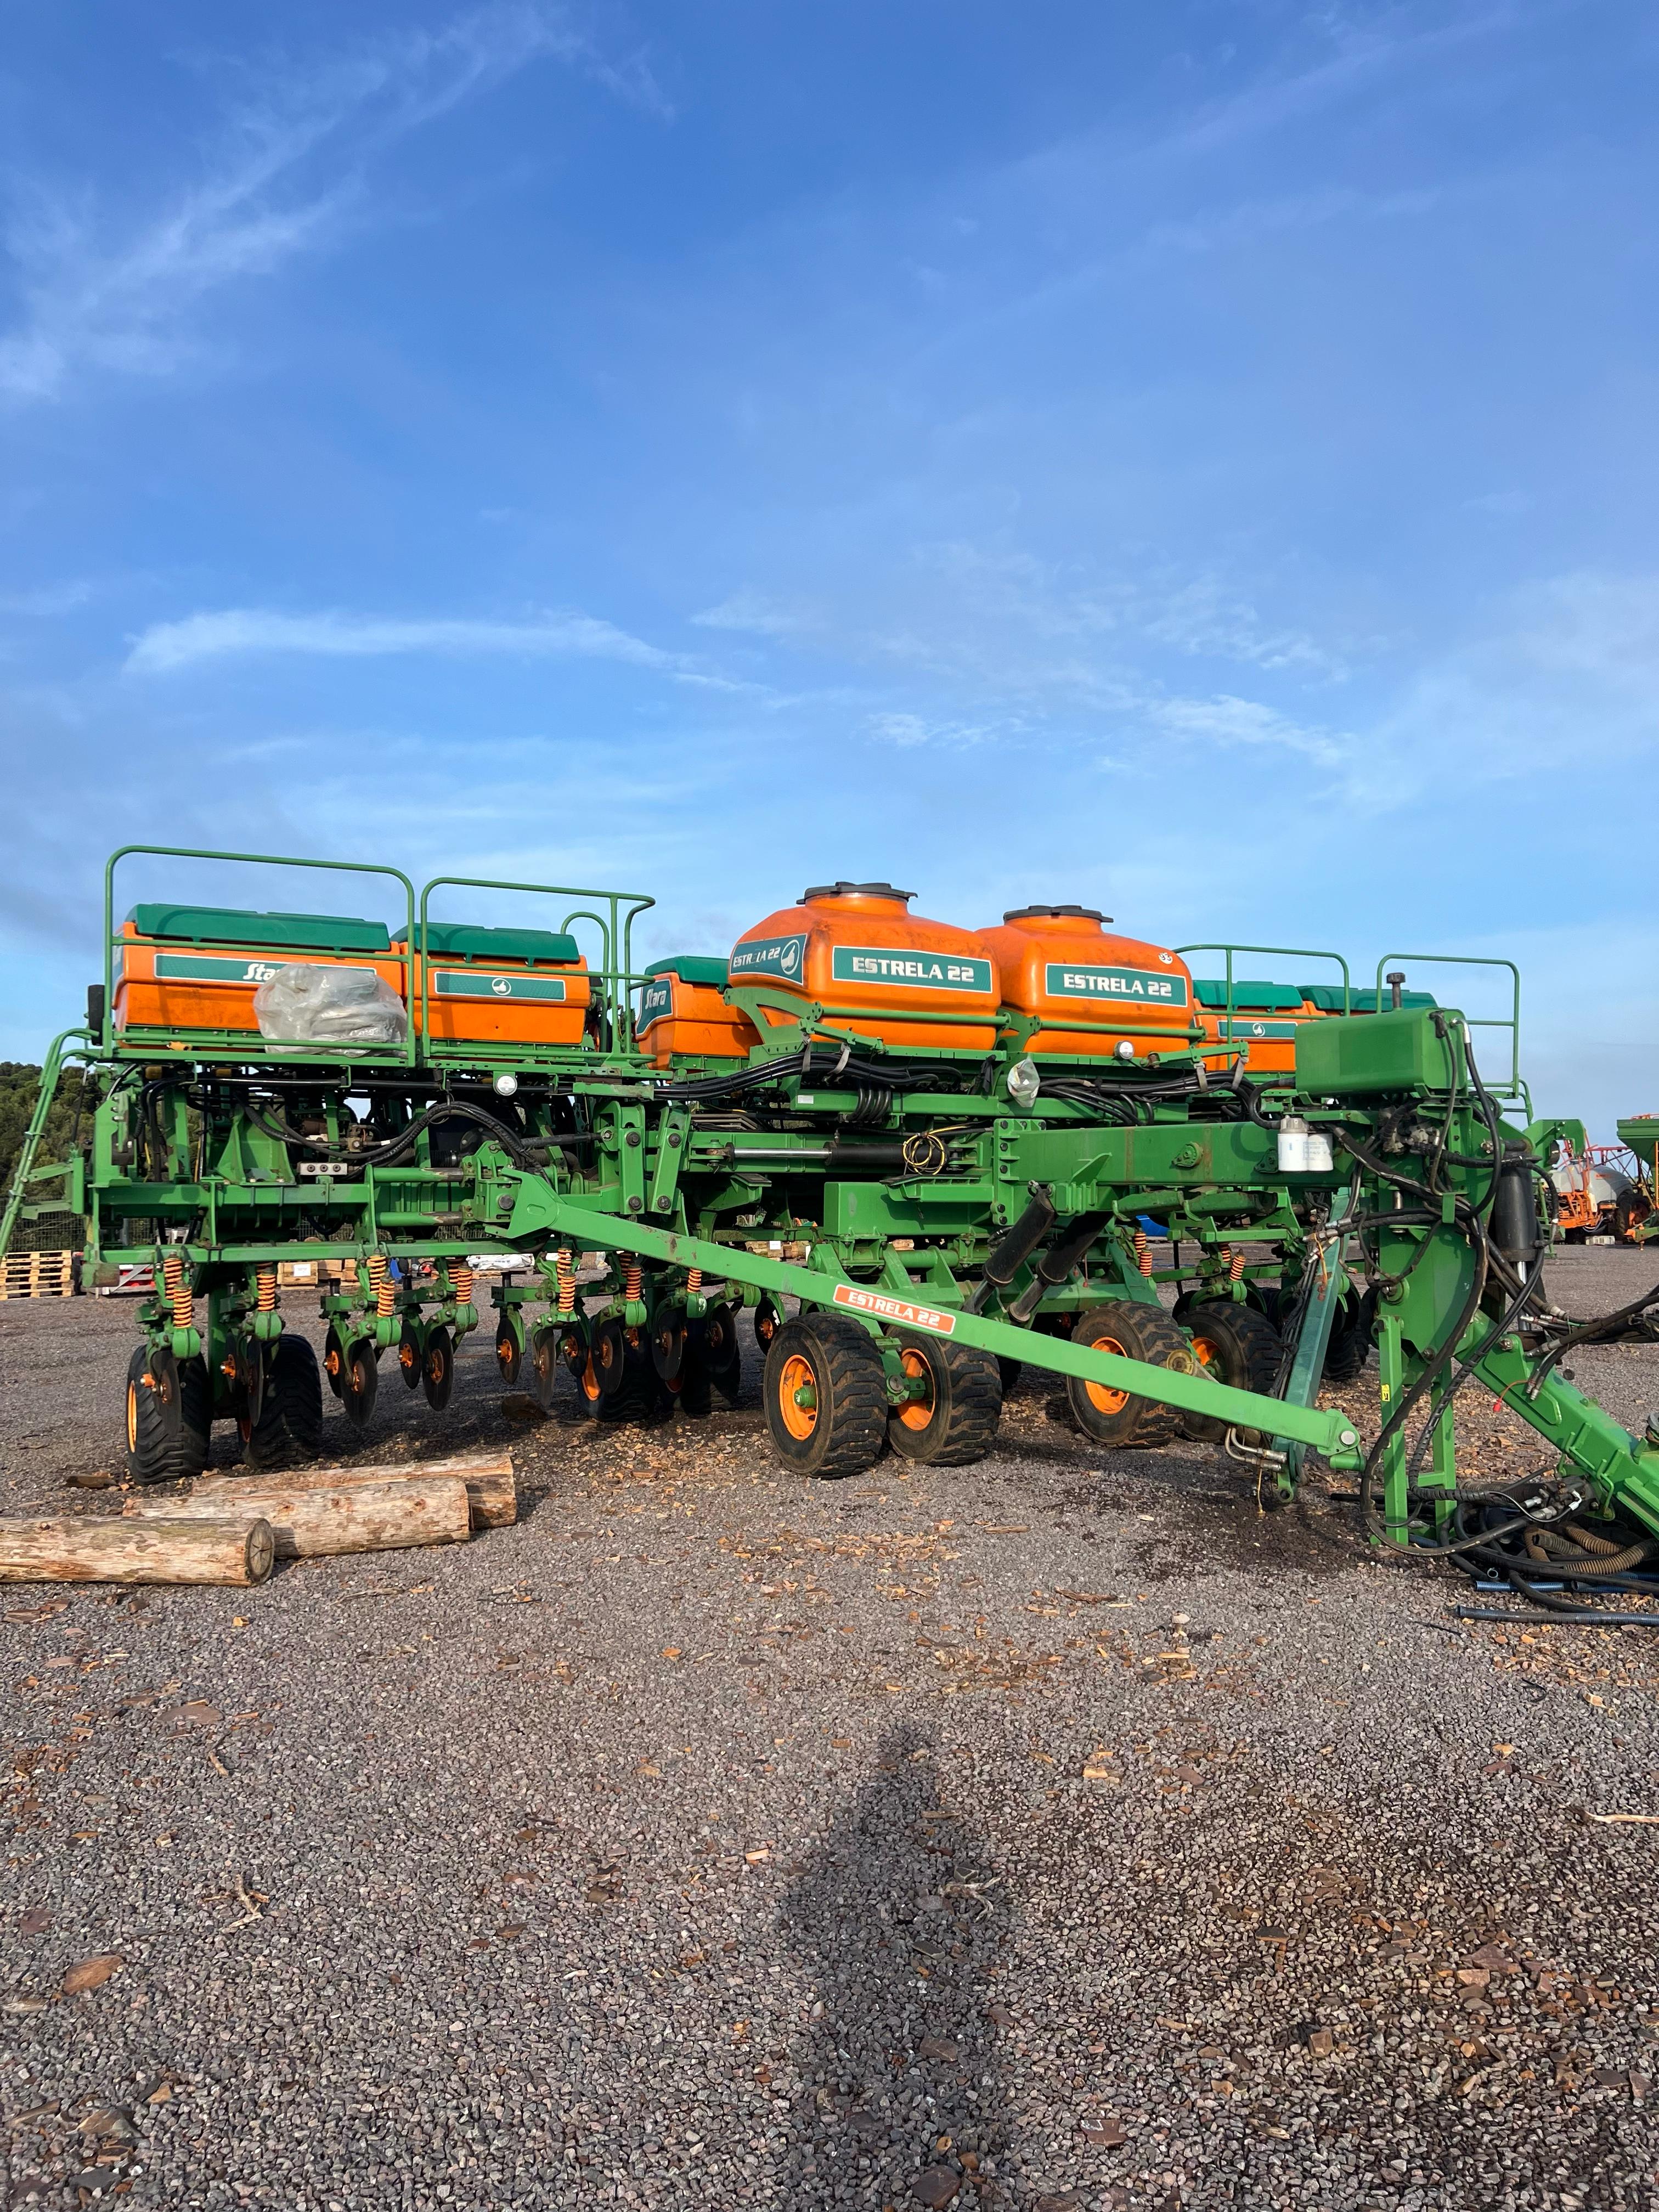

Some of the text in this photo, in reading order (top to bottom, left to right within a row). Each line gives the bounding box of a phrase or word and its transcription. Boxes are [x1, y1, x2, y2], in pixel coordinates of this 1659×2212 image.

[733, 947, 781, 968] ESTRLA 22
[242, 963, 280, 980] Sta
[853, 957, 974, 983] ESTRELA 22
[1063, 974, 1172, 997] ESTRELA 22
[645, 989, 667, 1009] Stara
[848, 1291, 940, 1327] ESTRELA 22
